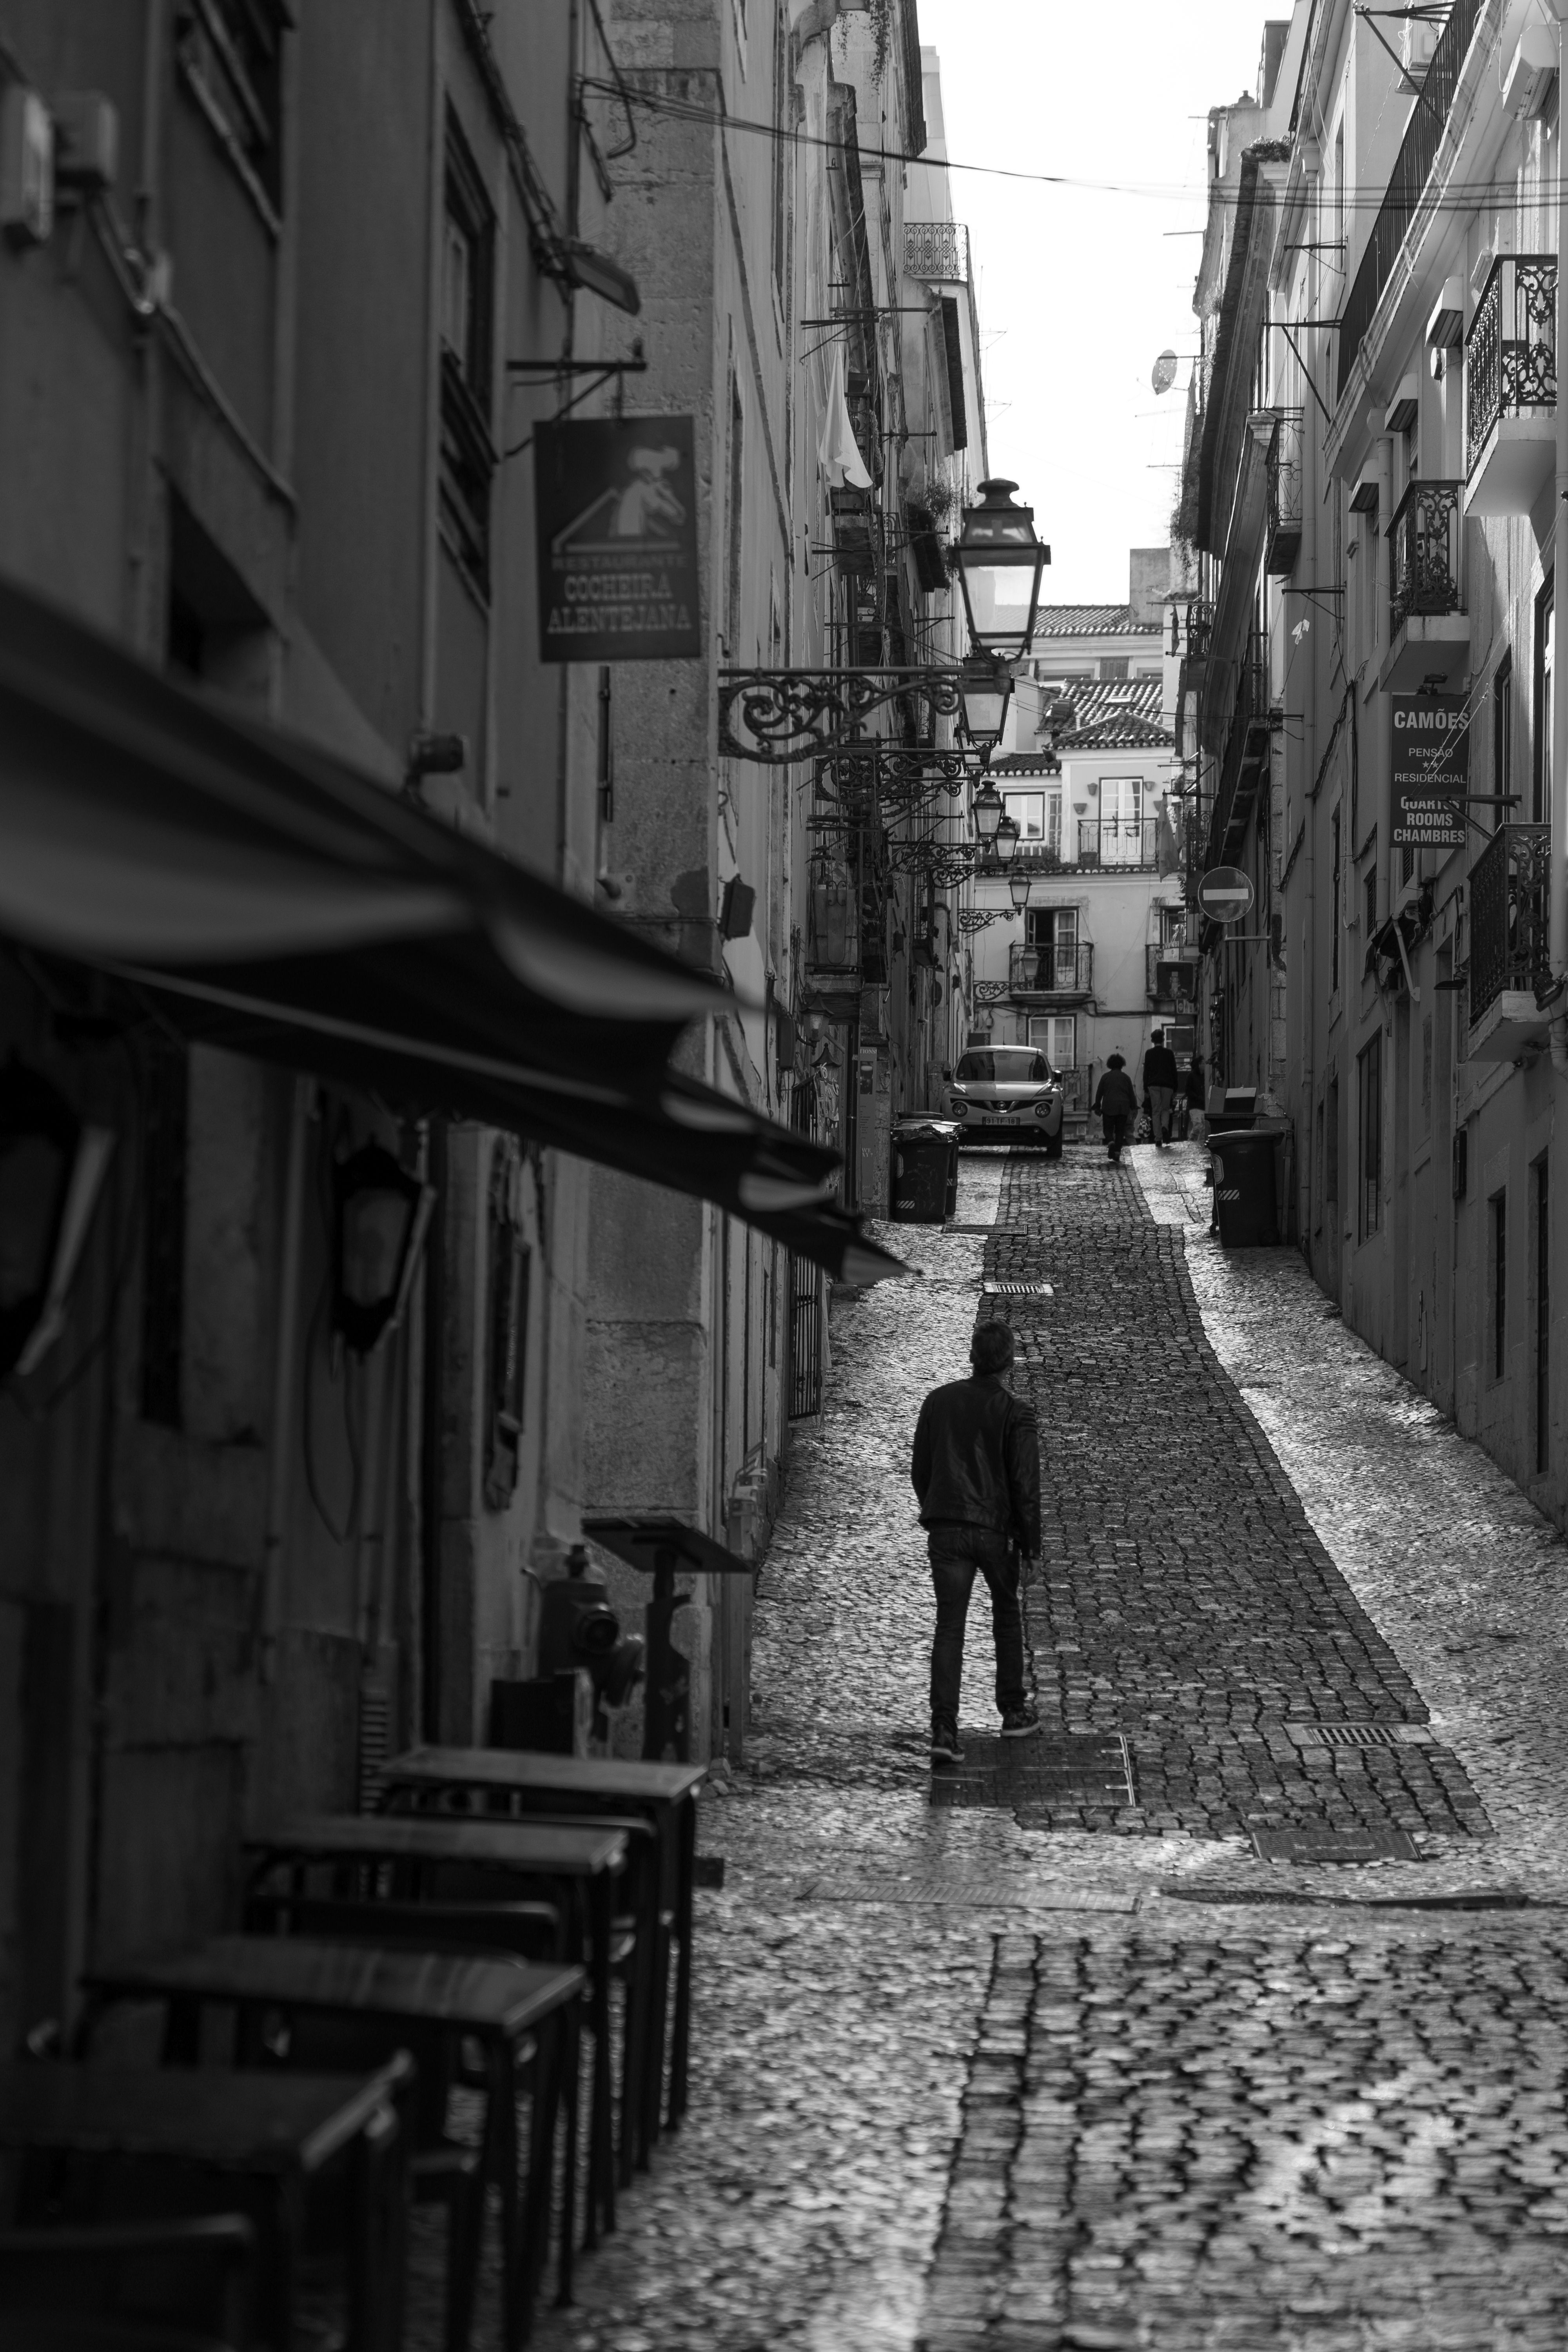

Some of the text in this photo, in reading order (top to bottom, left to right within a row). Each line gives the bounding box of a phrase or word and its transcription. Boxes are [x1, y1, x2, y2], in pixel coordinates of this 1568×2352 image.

[564, 572, 673, 602] COCHEIRA
[547, 603, 692, 634] ALENTEJANA
[1394, 708, 1469, 730] CAMÕES
[1408, 747, 1453, 757] PENSÃO
[1394, 773, 1466, 783] RESIDENCIAL
[1407, 813, 1453, 826] ROOMS
[1394, 828, 1465, 843] CHAMBRES
